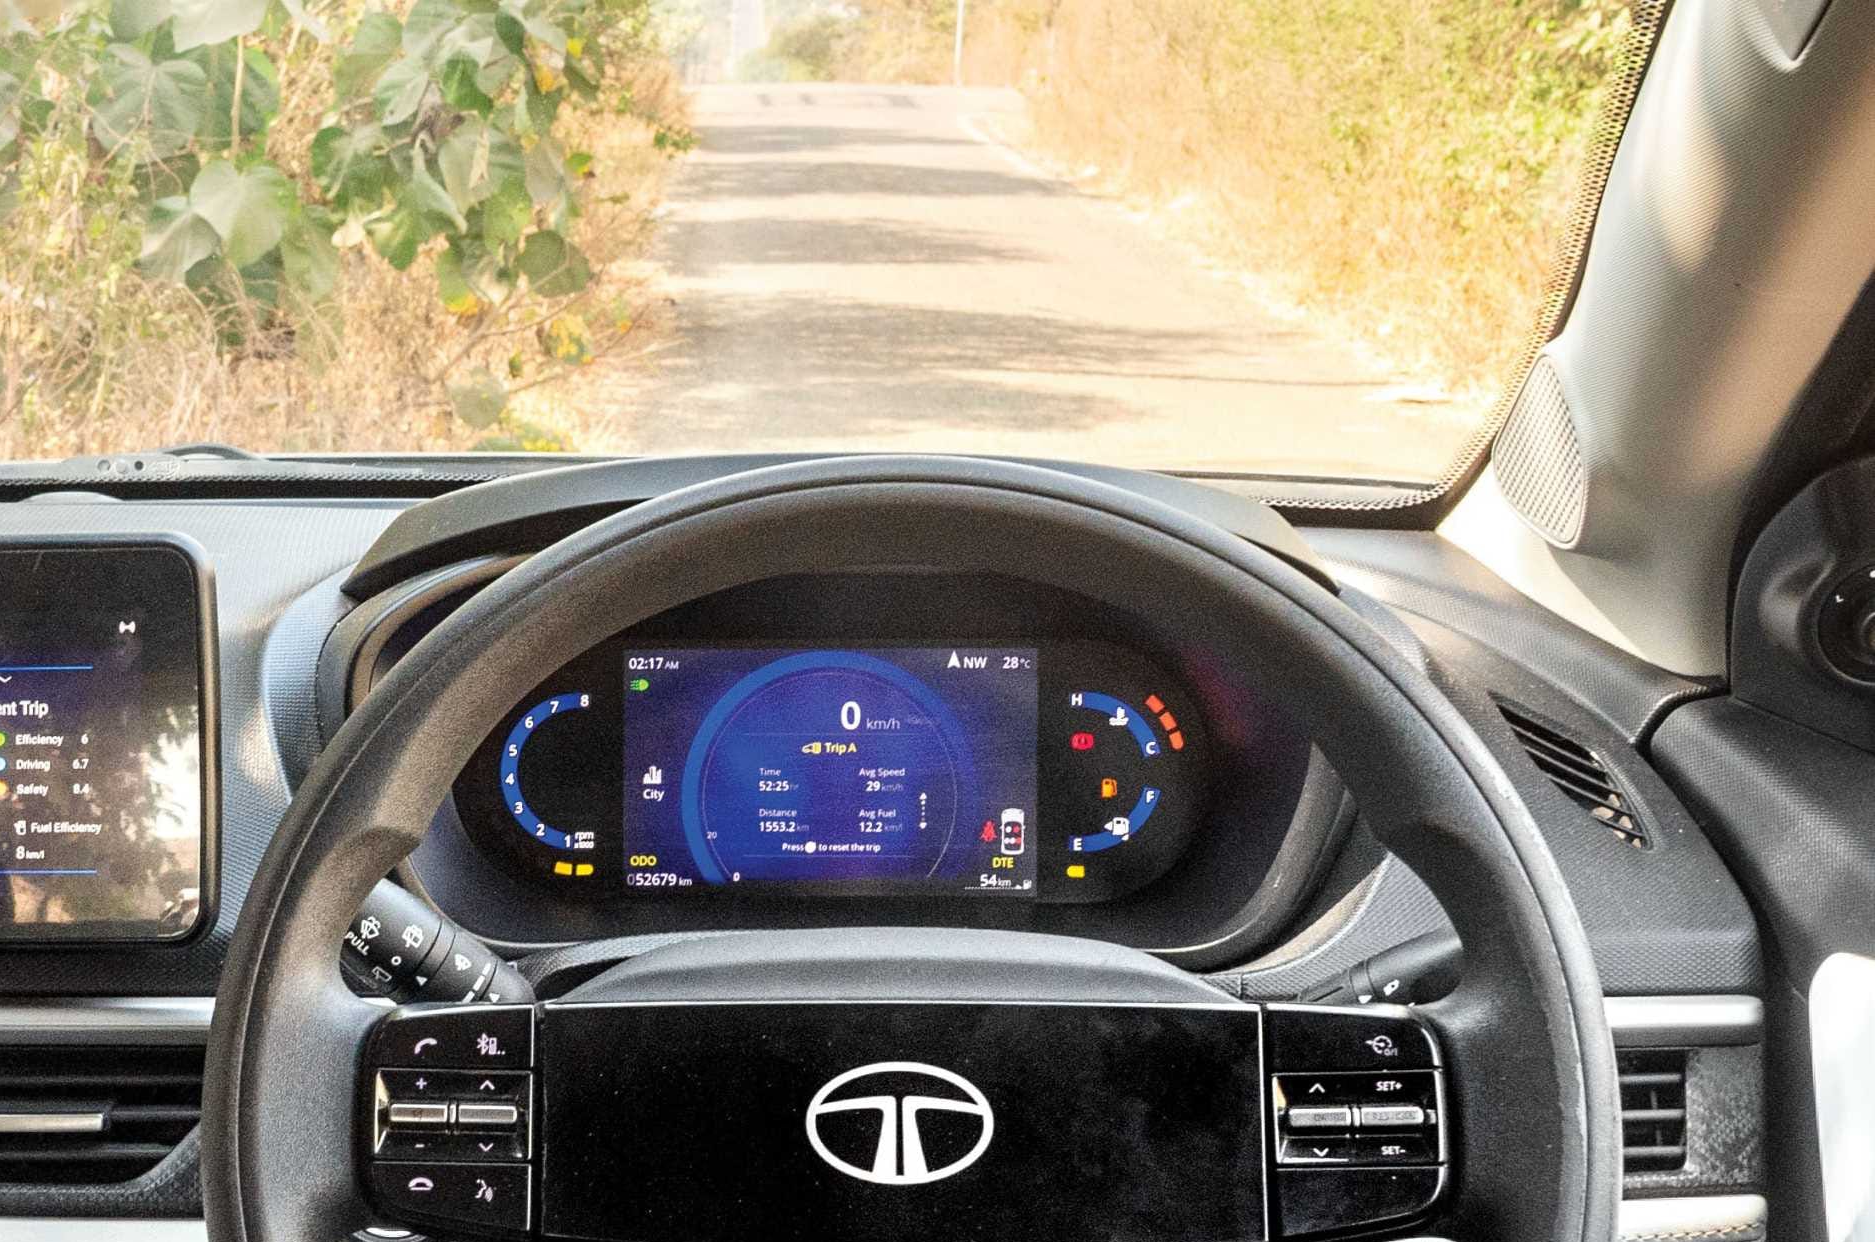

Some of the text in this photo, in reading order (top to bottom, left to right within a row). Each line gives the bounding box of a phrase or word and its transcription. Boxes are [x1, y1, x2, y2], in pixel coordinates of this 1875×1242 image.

[628, 657, 679, 670] 02:17 AM
[963, 657, 987, 669] NW
[580, 694, 589, 707] 8
[1071, 694, 1083, 706] H
[19, 700, 49, 718] Trip
[550, 701, 559, 713] 7
[840, 701, 901, 730] 0 km/h
[525, 716, 534, 729] 6
[15, 734, 89, 747] Efficiency 6
[508, 744, 518, 757] 5
[824, 742, 857, 756] Trip A
[1145, 741, 1157, 755] C
[16, 759, 89, 772] Driving 6.7
[759, 768, 782, 777] Time
[859, 768, 906, 778] Avg Speed
[505, 773, 514, 785] 4
[16, 784, 49, 796] Safety
[758, 781, 790, 792] 52:25
[865, 781, 881, 792] 29
[643, 789, 665, 802] City
[1145, 790, 1155, 804] F
[514, 802, 523, 814] 3
[758, 808, 798, 818] Distance
[859, 809, 896, 819] Avg Fuel
[30, 823, 102, 835] Fuel Efficiency
[536, 824, 545, 836] 2
[758, 822, 796, 833] 1553.2
[859, 822, 883, 833] 12.2
[564, 835, 571, 848] 1
[574, 831, 595, 842] rpm
[781, 842, 881, 853] Press to reset the trip
[1073, 838, 1083, 851] E
[15, 846, 25, 860] 8
[629, 855, 658, 866] ODO
[991, 857, 1014, 869] DTE
[678, 877, 693, 886] km
[979, 874, 1012, 887] 54 km
[344, 931, 371, 956] PULL
[1375, 1081, 1403, 1092] SET+
